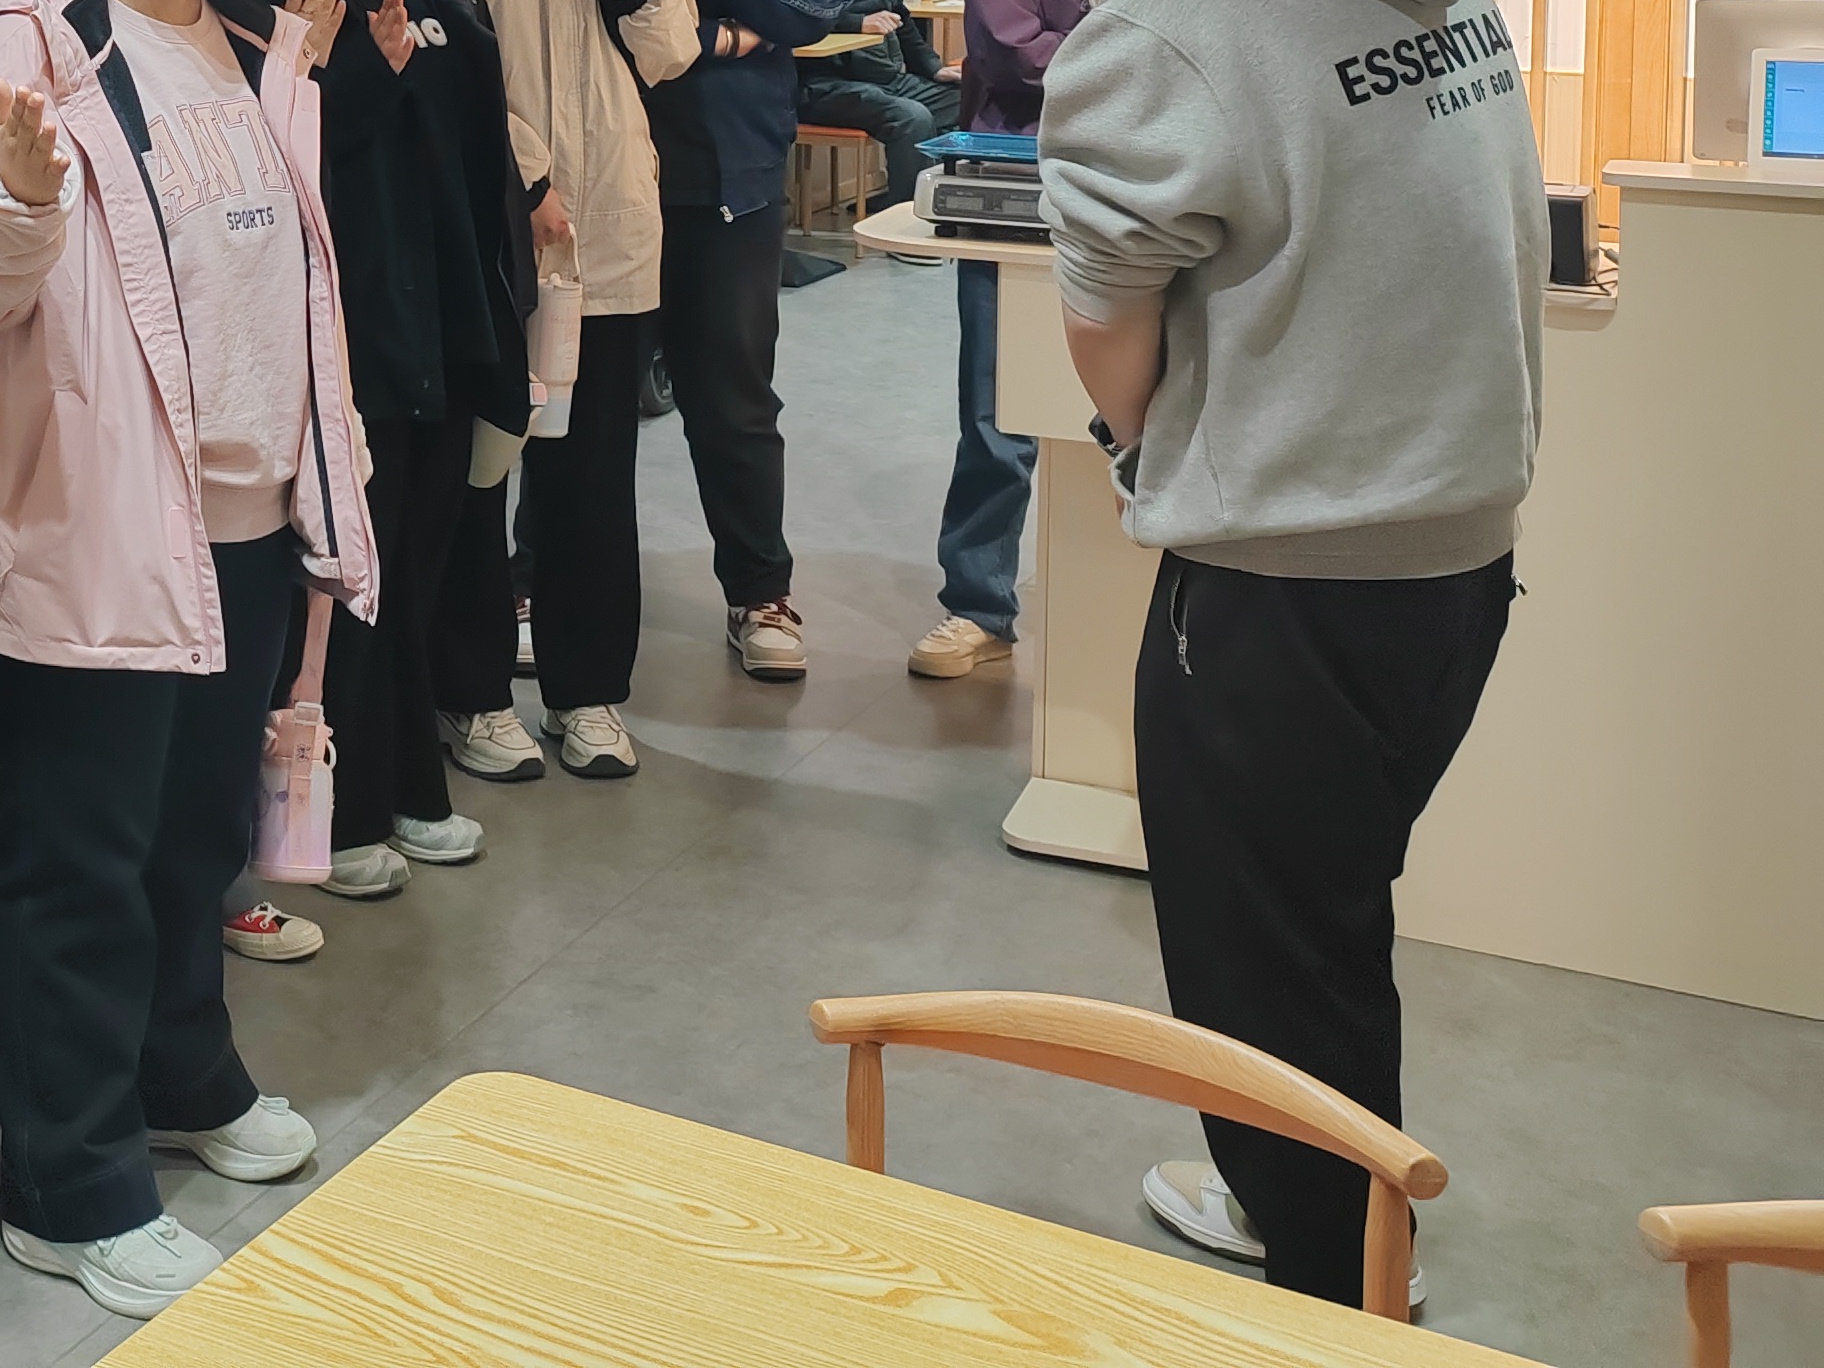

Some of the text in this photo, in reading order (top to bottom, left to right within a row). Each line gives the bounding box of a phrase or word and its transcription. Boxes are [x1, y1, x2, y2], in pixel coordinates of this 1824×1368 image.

[1425, 69, 1514, 120] FEAR OF GOD
[225, 205, 275, 232] SPORTS
